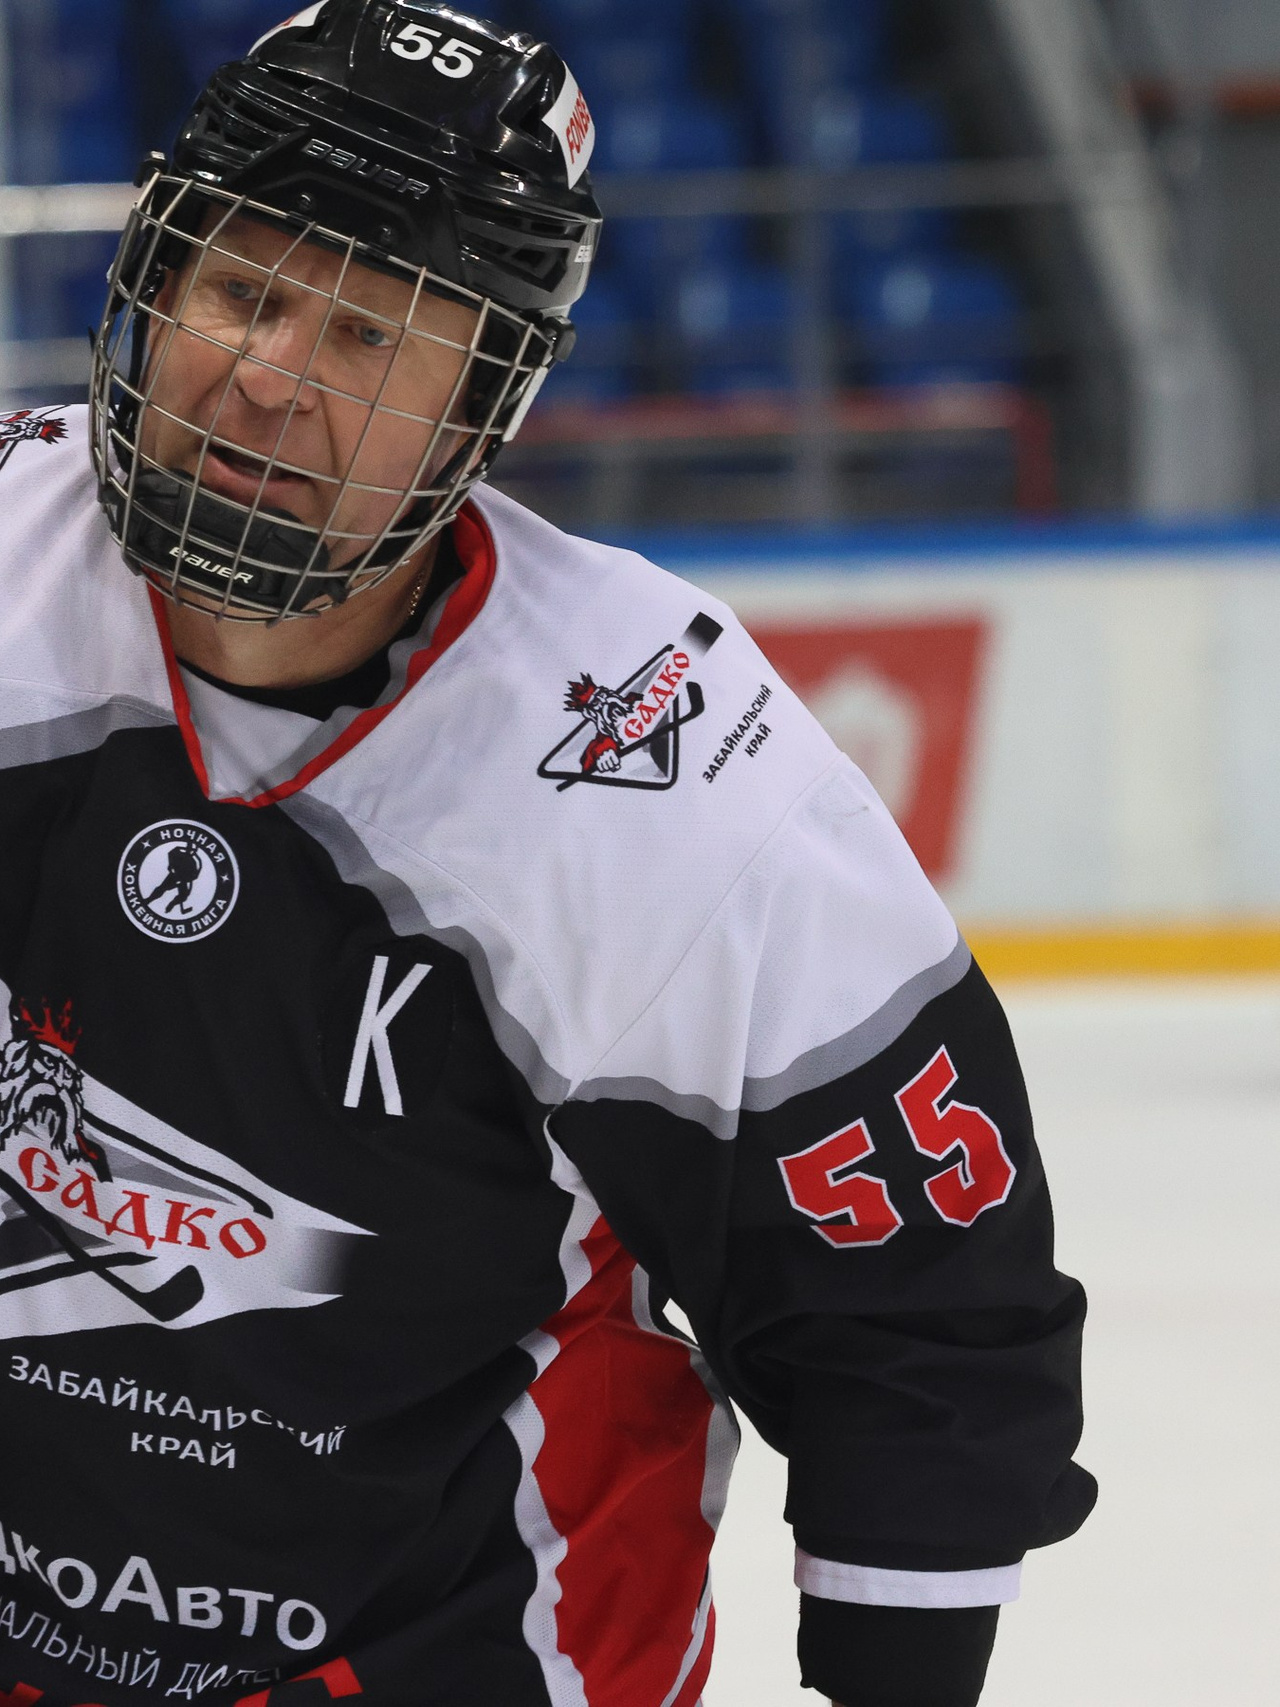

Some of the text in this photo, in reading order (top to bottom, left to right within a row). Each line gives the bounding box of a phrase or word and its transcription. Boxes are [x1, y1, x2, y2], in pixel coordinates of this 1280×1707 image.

[390, 22, 483, 79] 55
[302, 138, 430, 200] BAUER
[168, 546, 255, 585] BAUER
[623, 651, 690, 739] САДКО
[702, 684, 773, 784] ЗАБАЙКАЛЬСКИЙ
[744, 721, 772, 757] КРАЙ
[160, 828, 226, 863] НОЧНАЯ
[191, 898, 228, 933] ЛИГА
[776, 1043, 1018, 1249] 55
[18, 1146, 267, 1259] САДКО
[131, 1432, 236, 1469] КРАЙ
